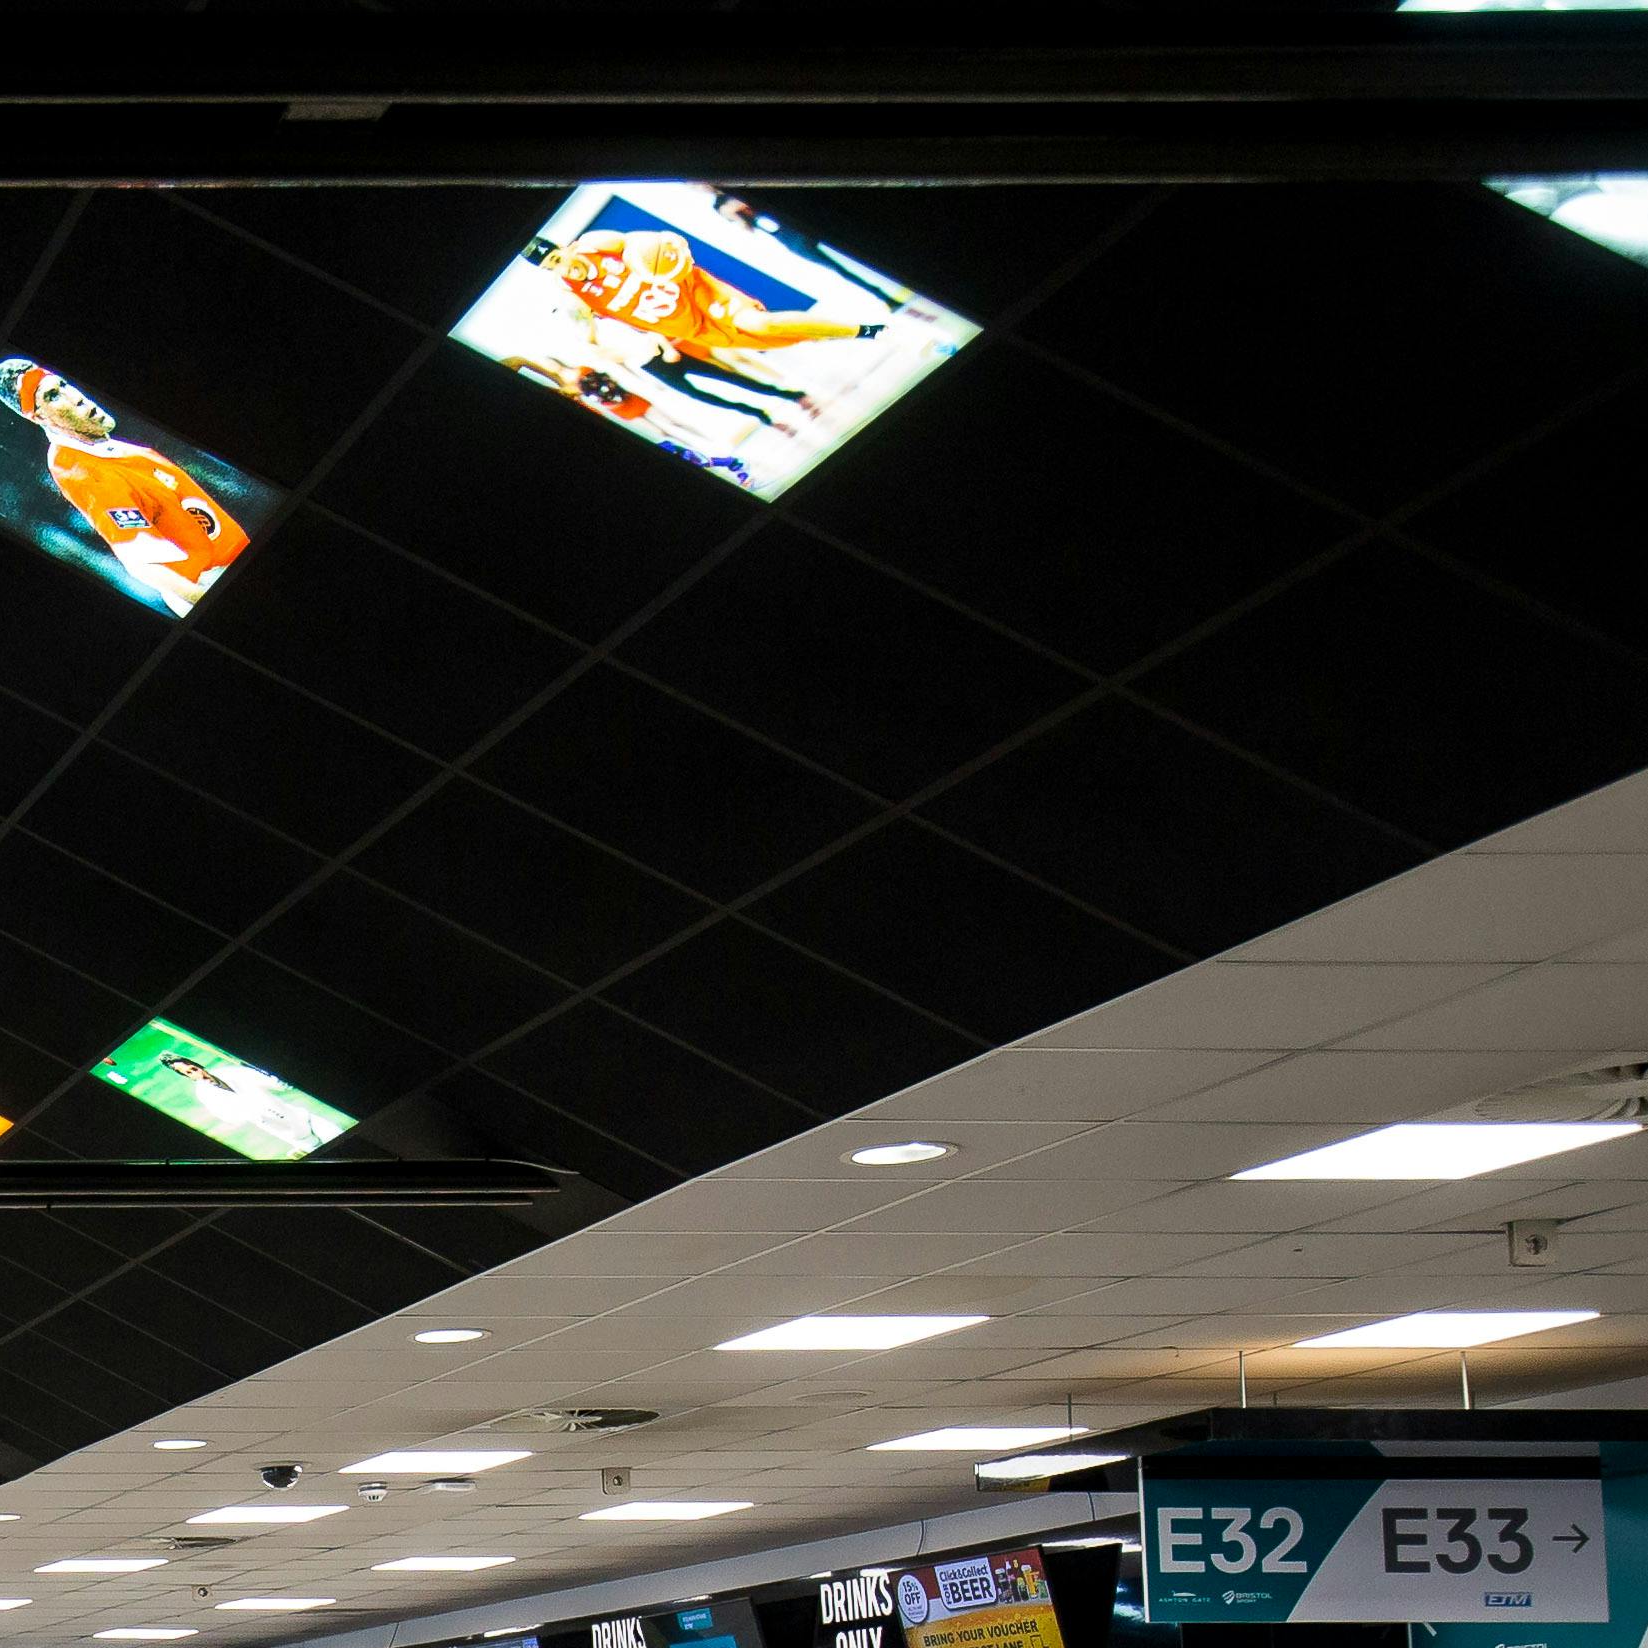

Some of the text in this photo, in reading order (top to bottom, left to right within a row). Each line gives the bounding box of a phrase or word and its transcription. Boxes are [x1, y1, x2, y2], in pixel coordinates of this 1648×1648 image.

[1157, 1507, 1534, 1574] E32 E33
[820, 1572, 893, 1625] DRINKS
[902, 1580, 919, 1592] 15%
[905, 1592, 921, 1606] OFF
[949, 1576, 993, 1606] BEER
[923, 1619, 1039, 1647] BRING YOUR VOUCHER
